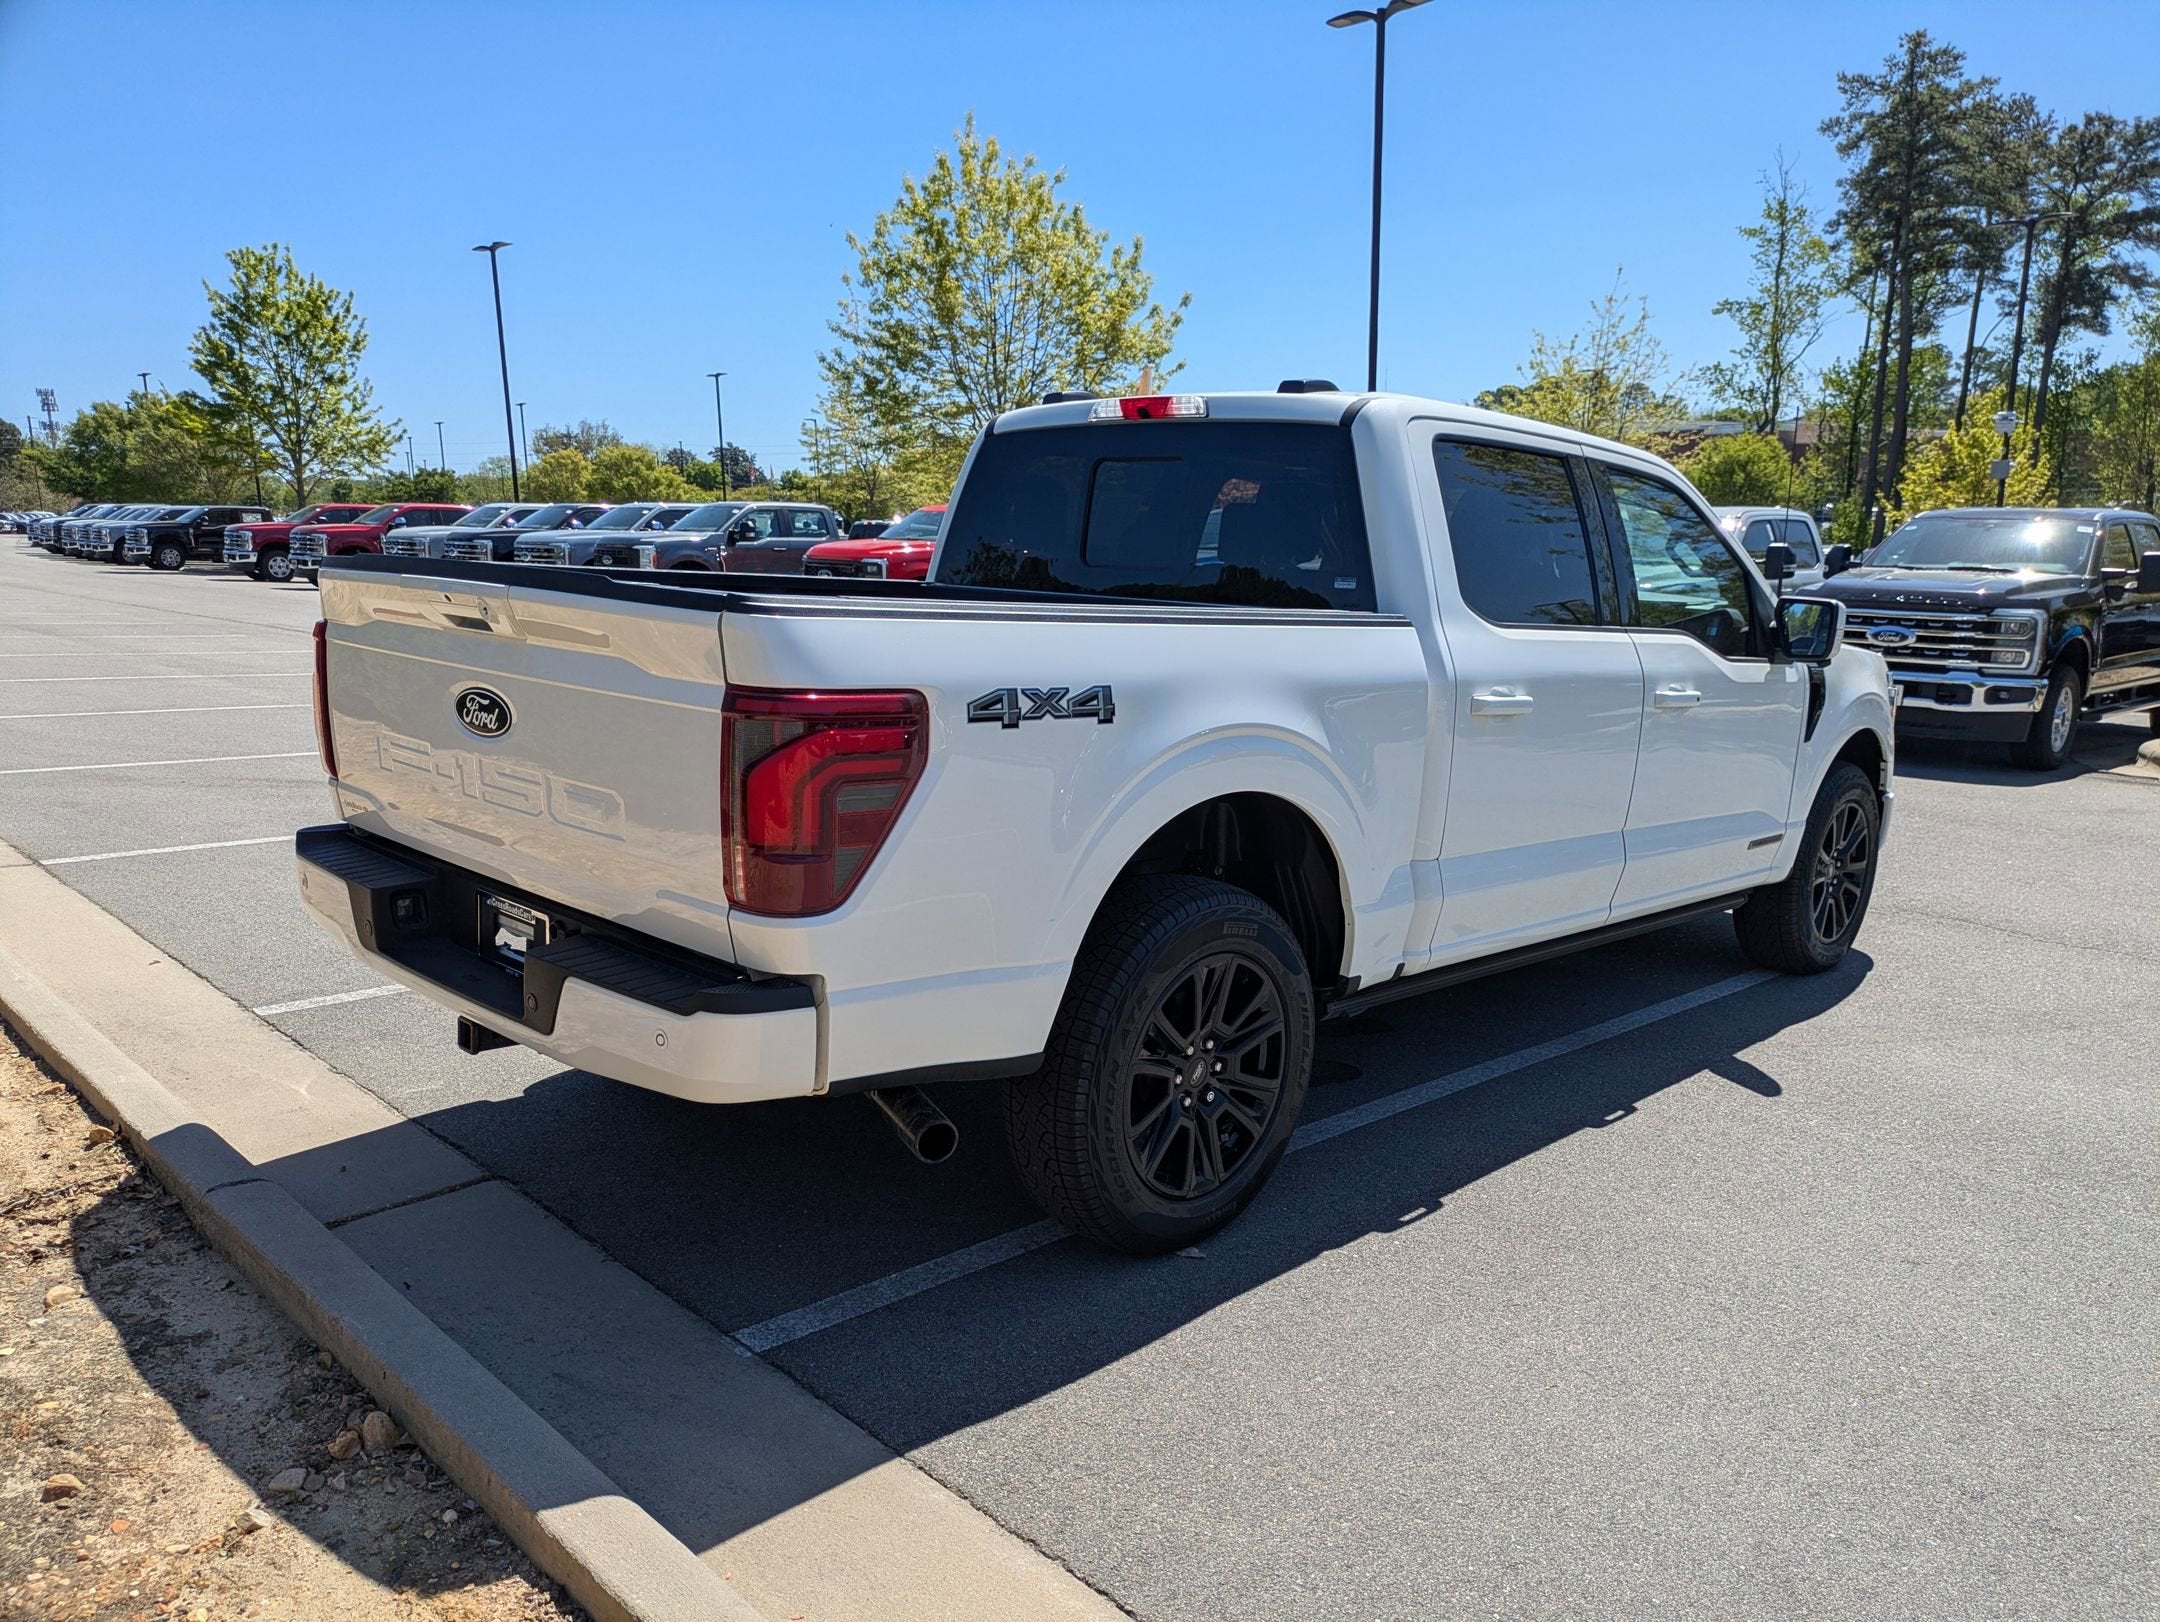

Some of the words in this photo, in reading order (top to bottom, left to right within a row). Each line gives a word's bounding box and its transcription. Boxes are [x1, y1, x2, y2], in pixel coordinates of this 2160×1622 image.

[463, 694, 499, 730] Ford
[376, 730, 626, 842] F-150
[1222, 921, 1258, 937] PIRELLI
